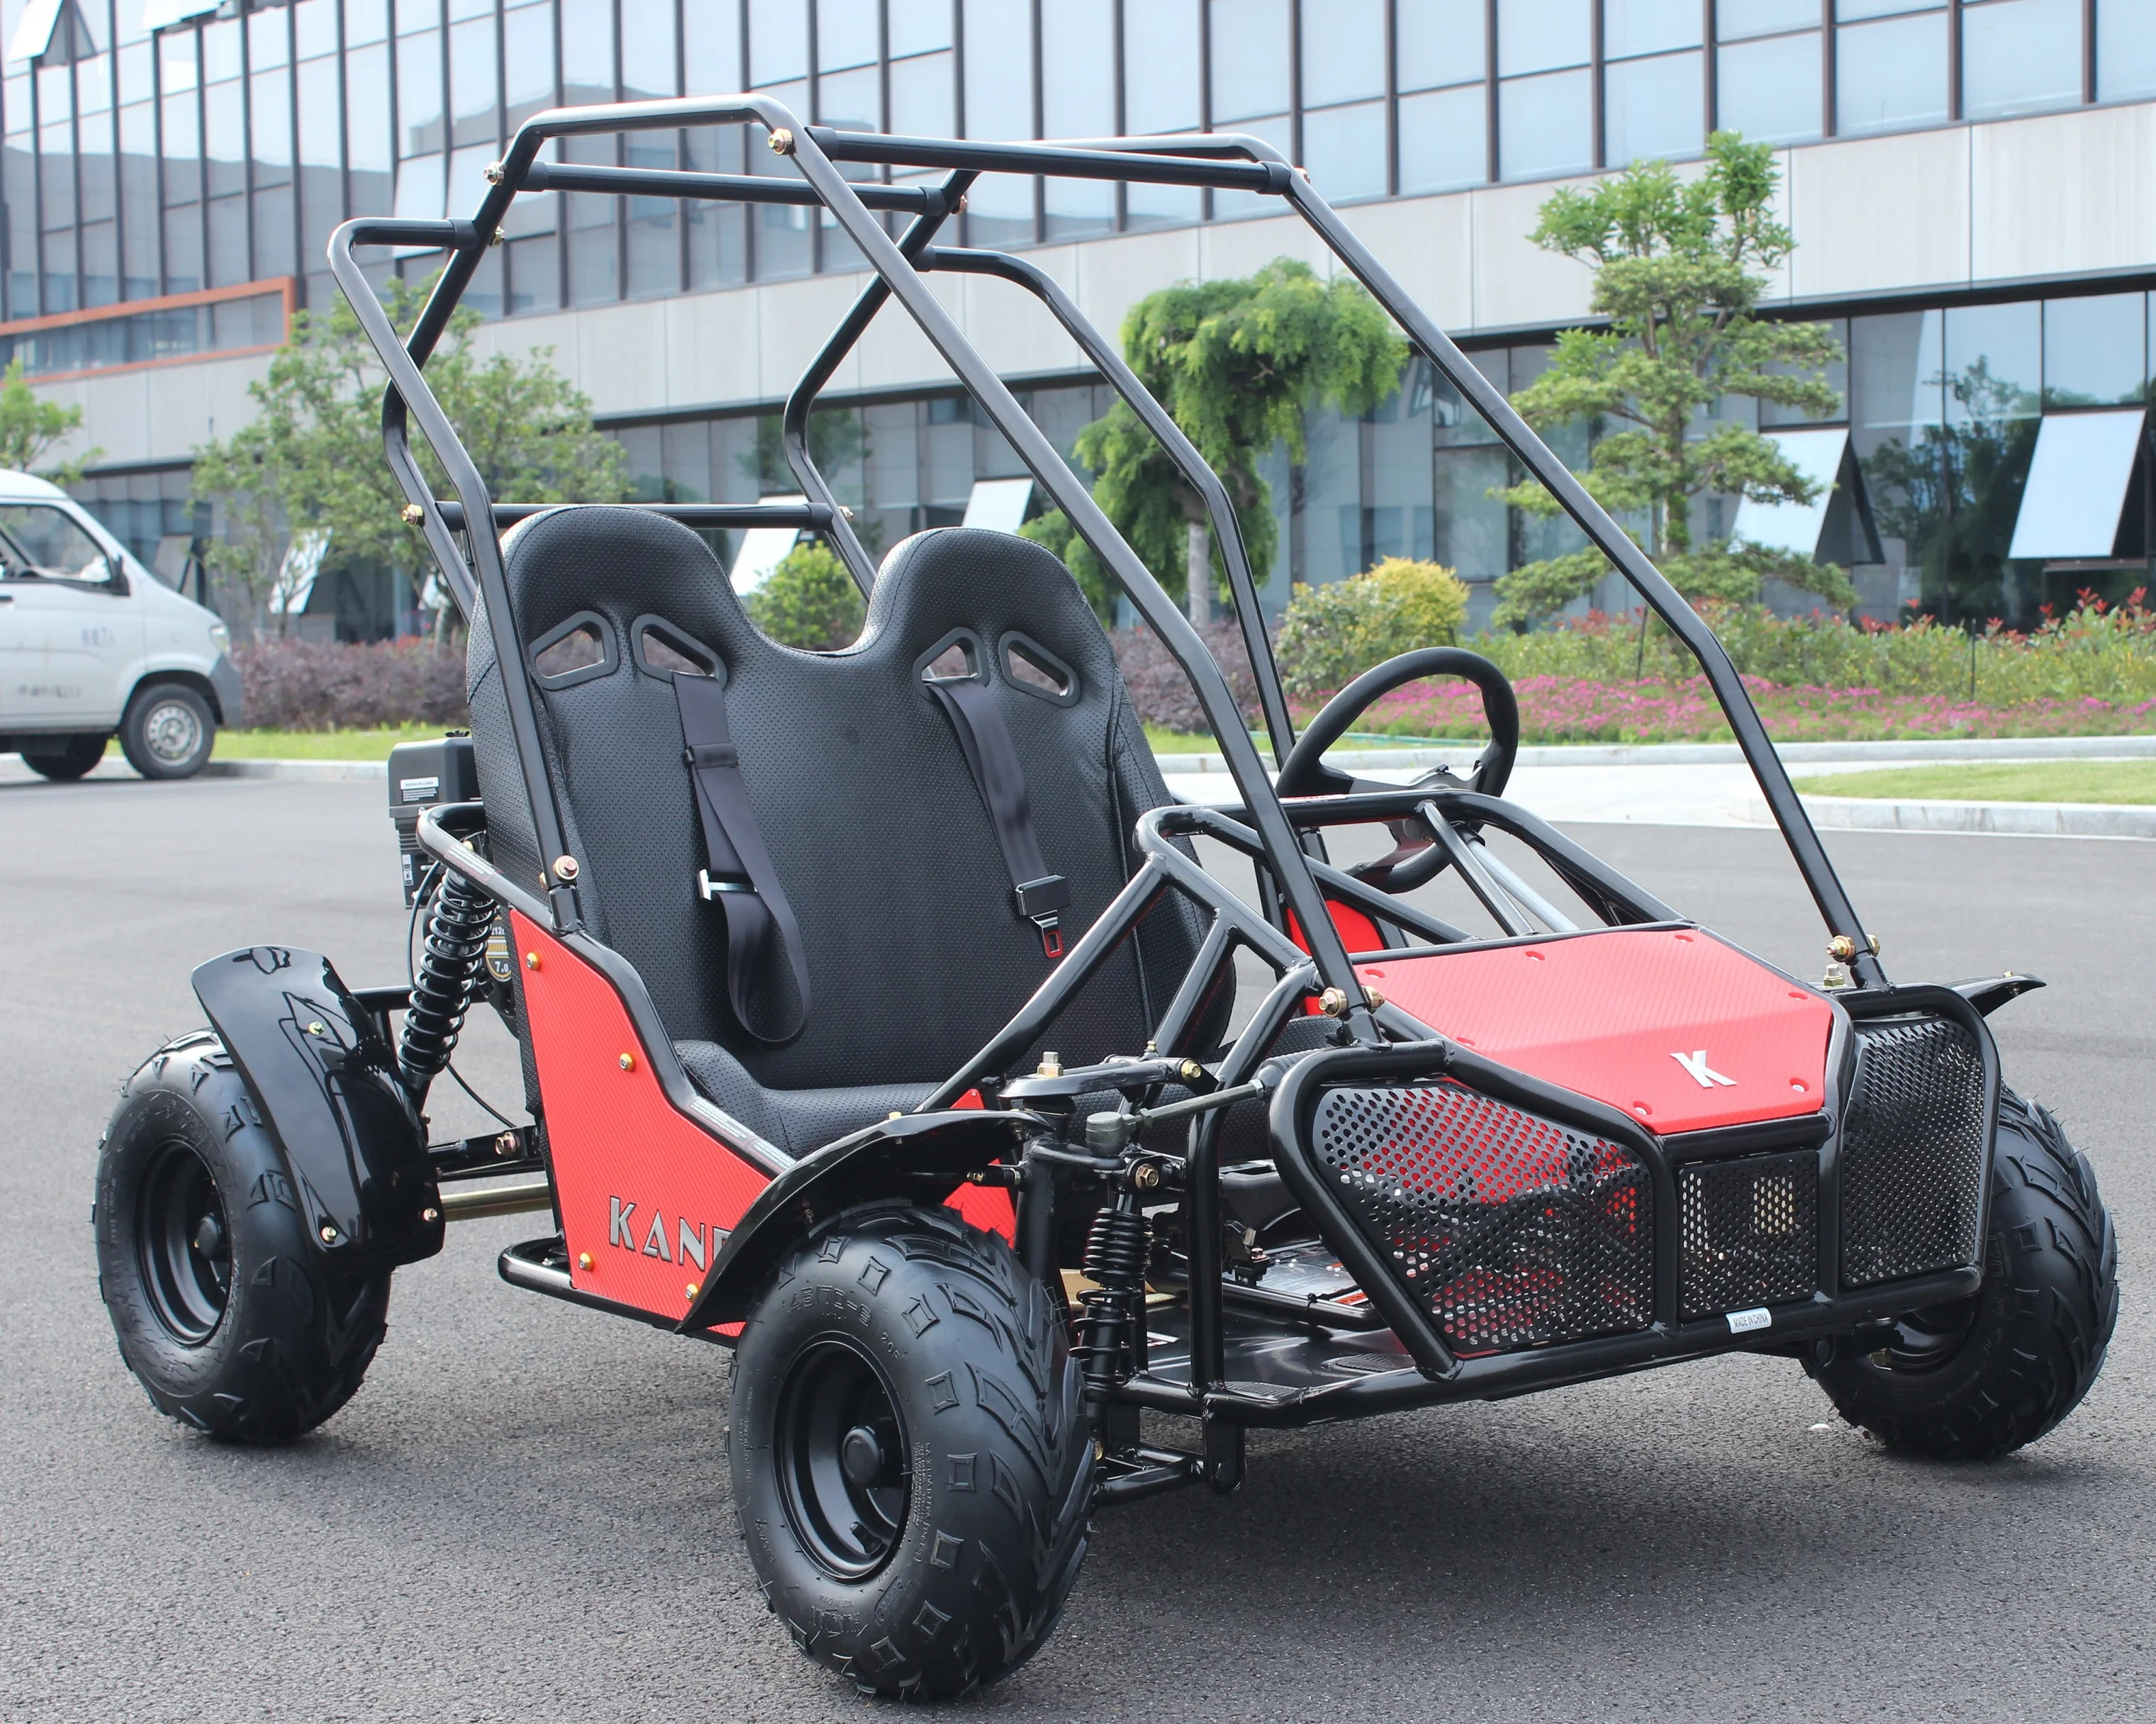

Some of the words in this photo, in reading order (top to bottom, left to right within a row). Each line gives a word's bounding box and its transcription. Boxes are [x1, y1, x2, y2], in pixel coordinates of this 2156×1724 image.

[495, 961, 509, 973] 7.0
[1669, 1050, 1738, 1088] K
[1732, 1316, 1748, 1328] MADE
[1746, 1314, 1754, 1326] IN
[1753, 1312, 1769, 1324] CHINA
